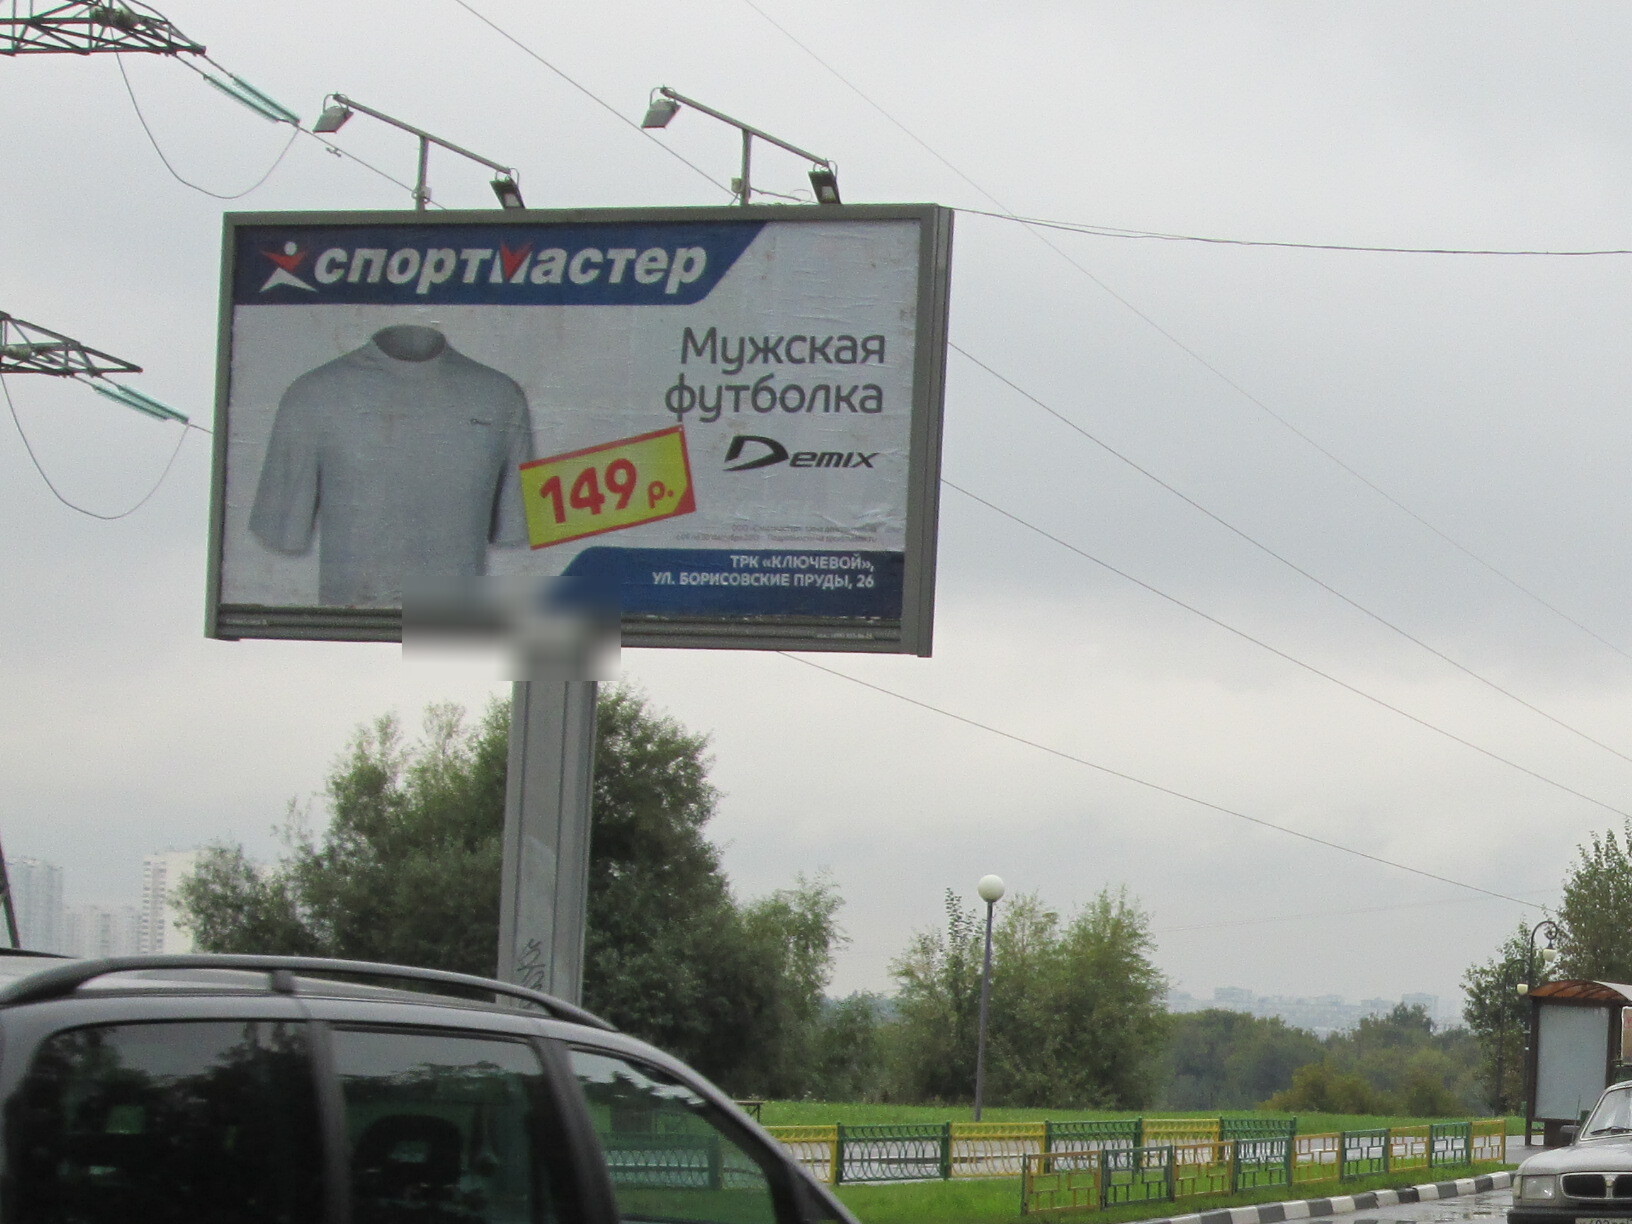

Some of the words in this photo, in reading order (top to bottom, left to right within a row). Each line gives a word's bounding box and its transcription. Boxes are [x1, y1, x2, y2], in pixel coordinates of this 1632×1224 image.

[680, 326, 885, 375] Мужская
[664, 372, 883, 422] футболка
[539, 457, 637, 524] 149
[647, 480, 674, 509] р.
[652, 571, 676, 585] УЛ.
[679, 572, 789, 586] БОРИСОВСКИЕ
[793, 573, 853, 590] ПРУДЫ,
[856, 574, 875, 588] 26
[730, 555, 759, 568] ТРК
[762, 553, 875, 572] «КЛЮЧЕВОЙ»,
